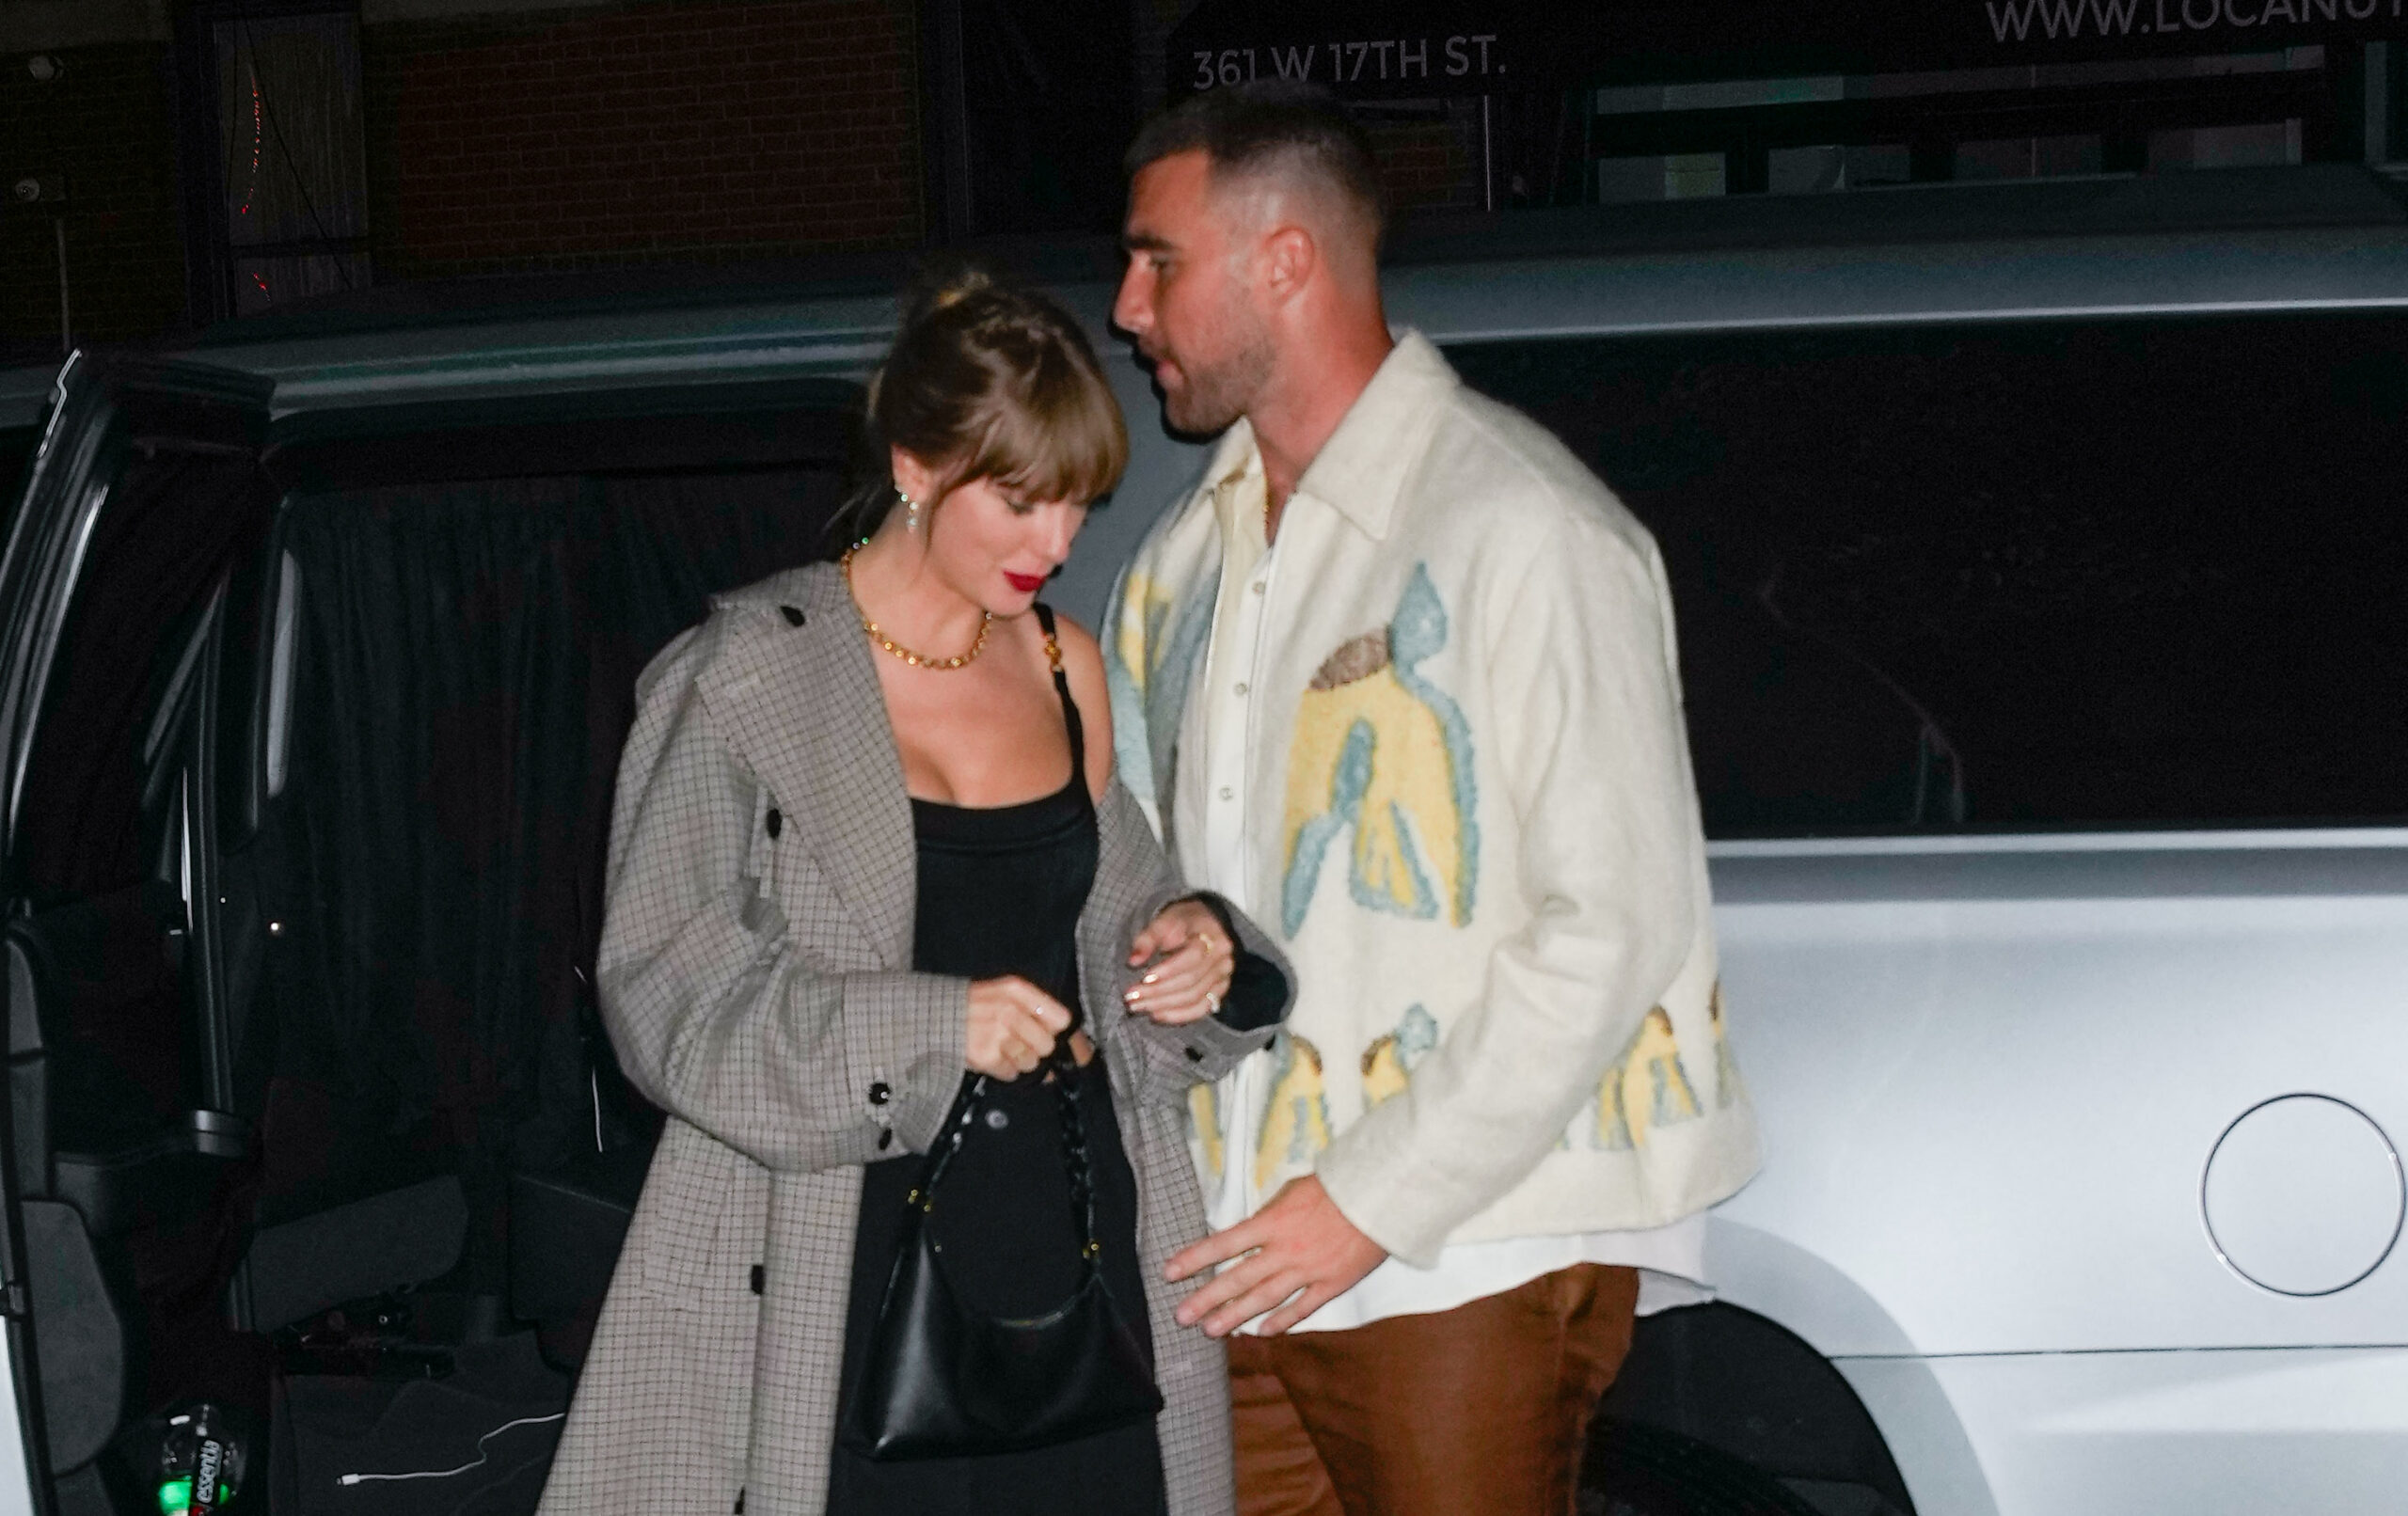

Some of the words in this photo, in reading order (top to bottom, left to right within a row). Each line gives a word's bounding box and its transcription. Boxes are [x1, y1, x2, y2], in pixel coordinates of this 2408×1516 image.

[1193, 49, 1256, 90] 361
[1271, 45, 1315, 83] W
[1328, 40, 1428, 82] 17TH
[1445, 35, 1506, 76] ST.
